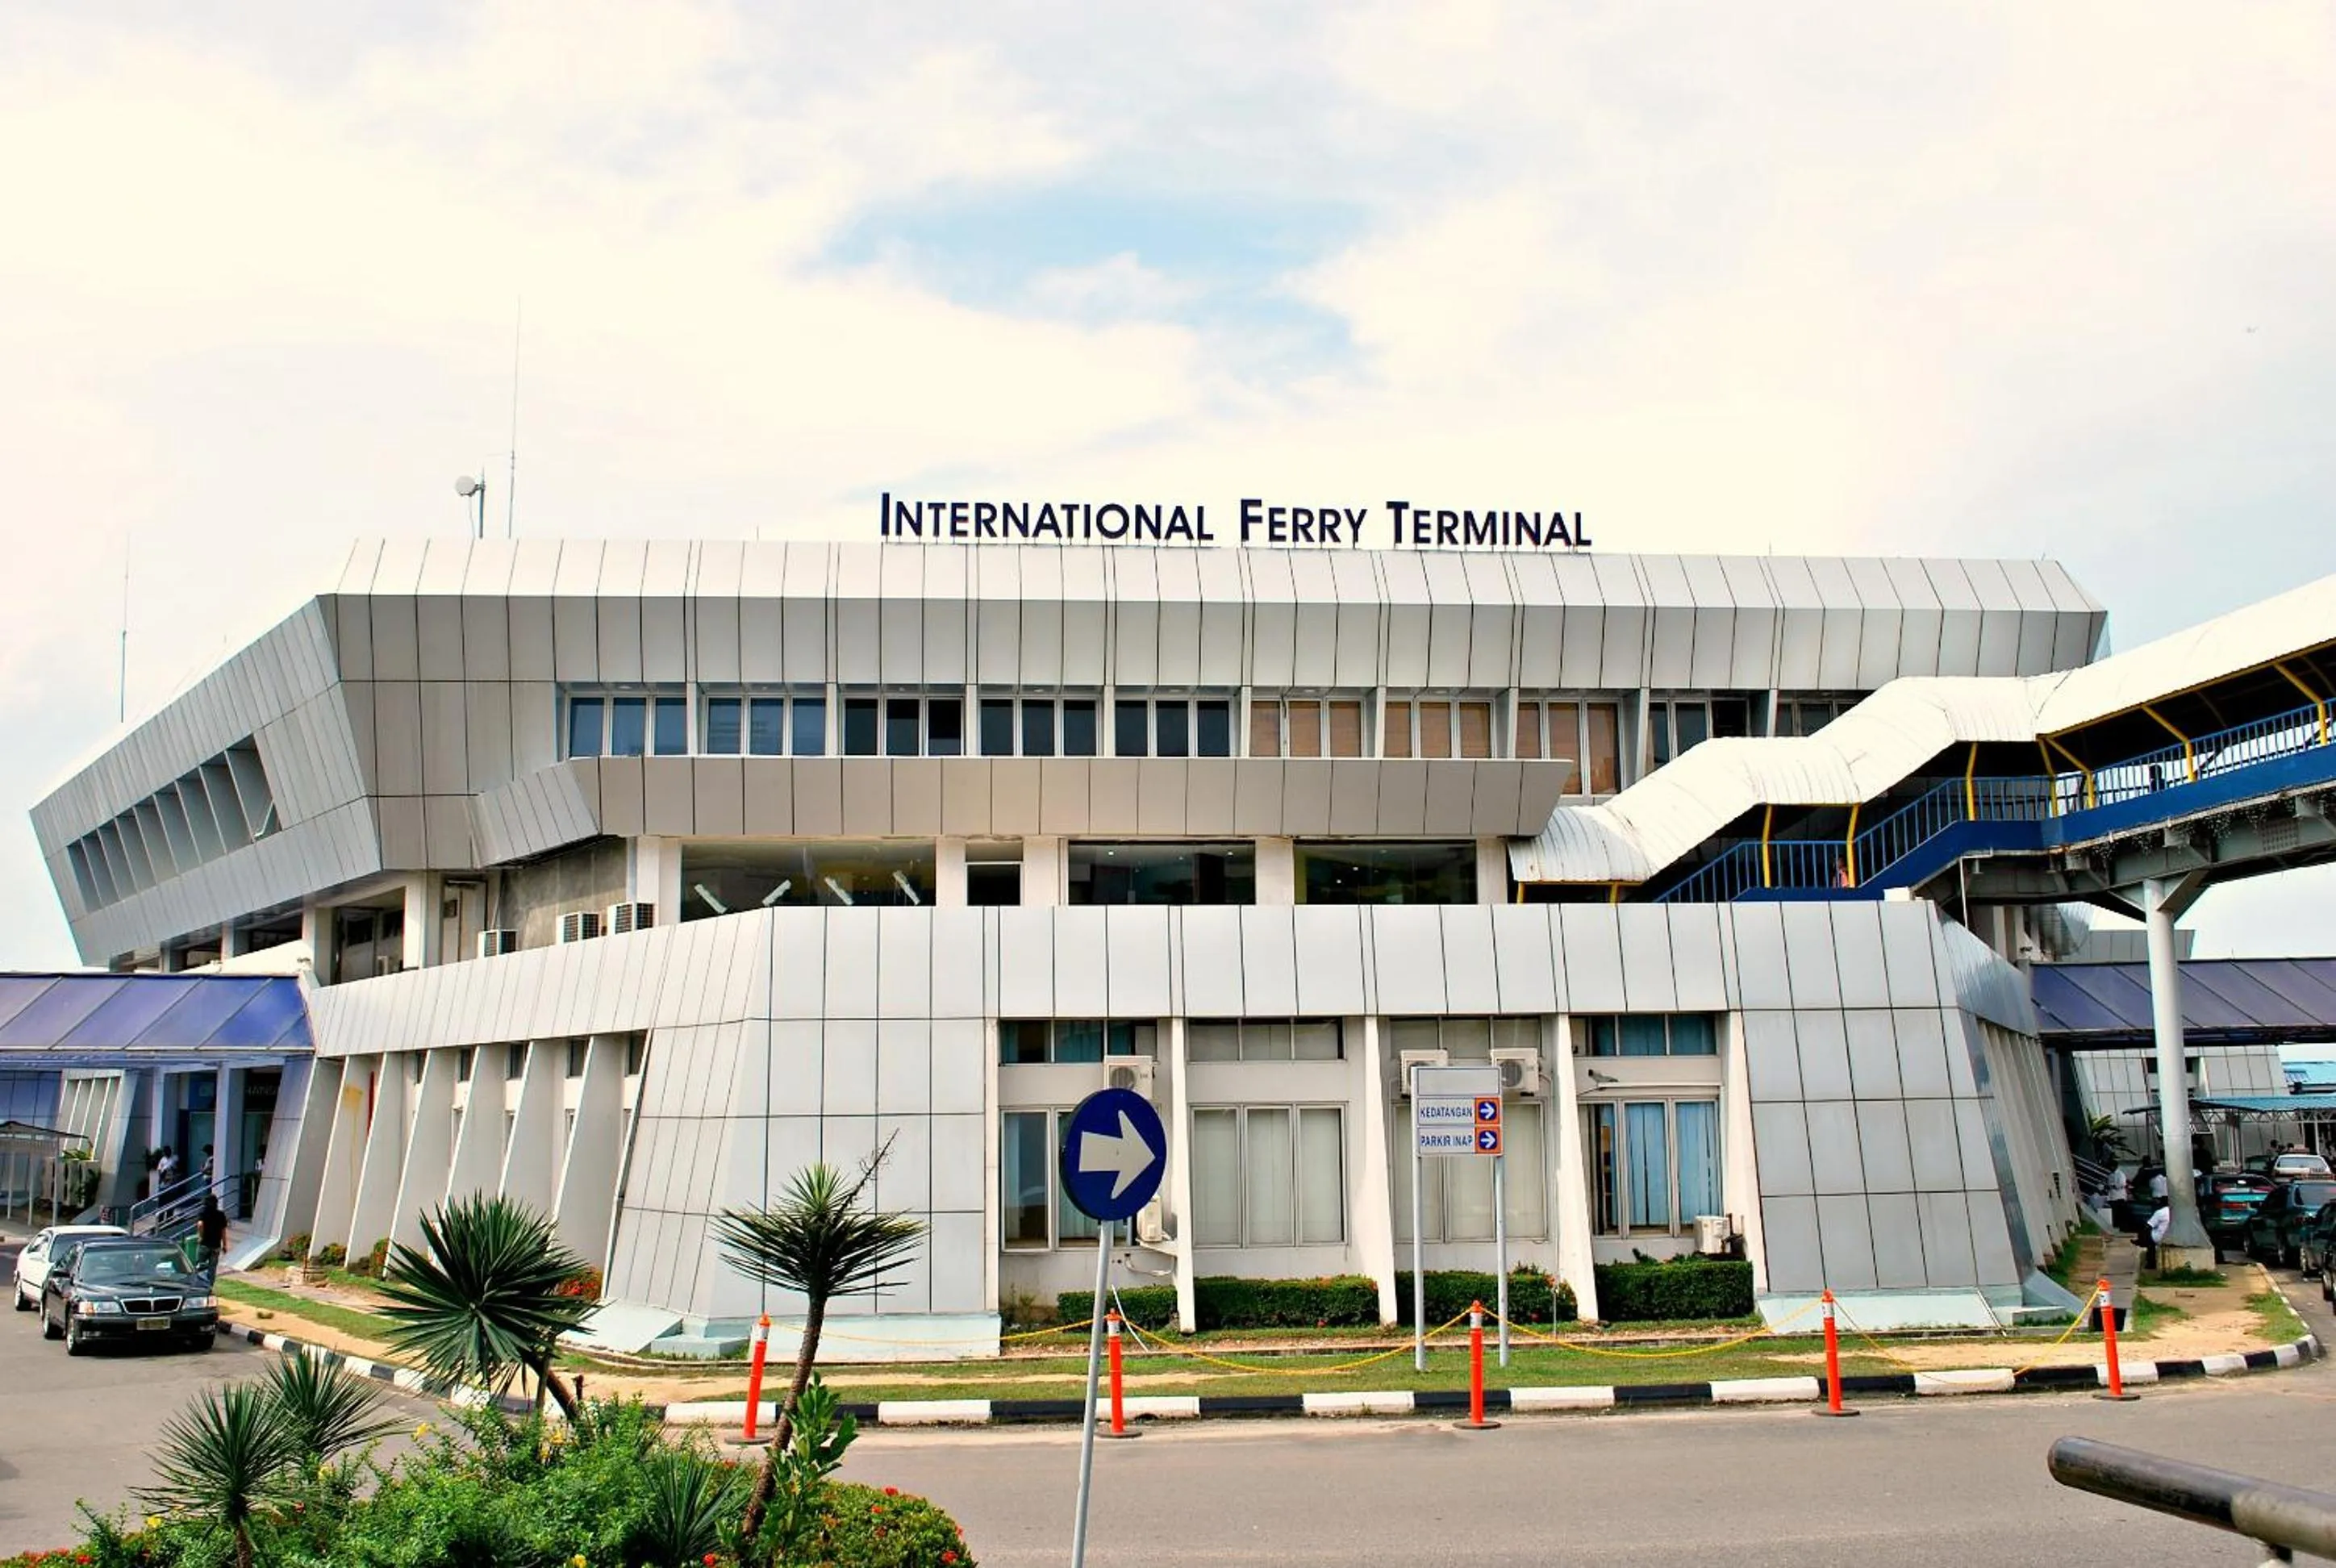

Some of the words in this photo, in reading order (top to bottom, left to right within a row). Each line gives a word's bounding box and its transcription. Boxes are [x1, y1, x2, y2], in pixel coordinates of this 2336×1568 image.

[882, 493, 1213, 540] INTERNATIONAL
[1241, 499, 1367, 544] FERRY
[1387, 501, 1592, 547] TERMINAL
[1420, 1106, 1473, 1119] KEDATANGAN
[1420, 1135, 1451, 1147] PARKIR
[1453, 1135, 1474, 1147] INAP
